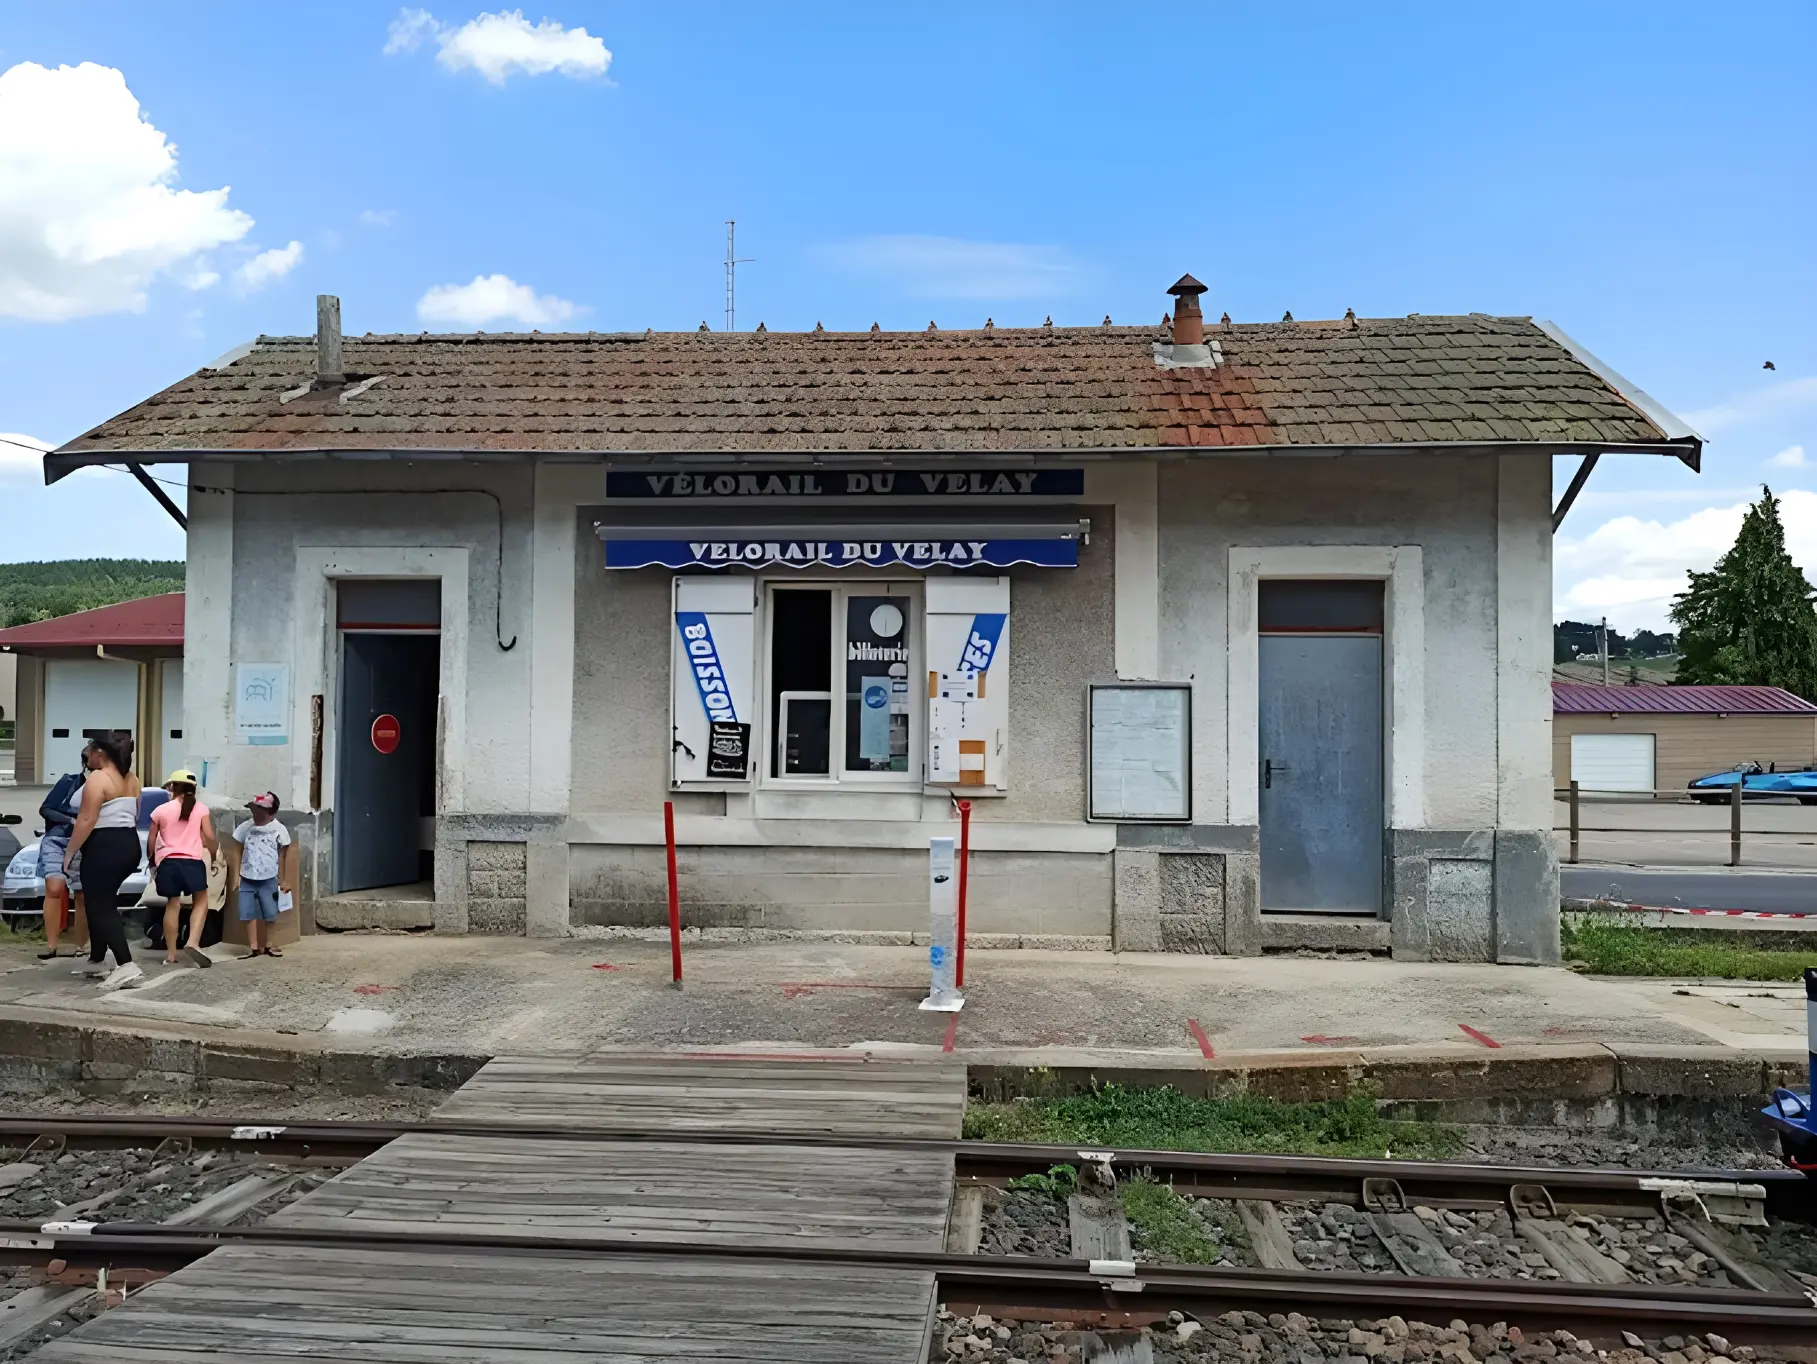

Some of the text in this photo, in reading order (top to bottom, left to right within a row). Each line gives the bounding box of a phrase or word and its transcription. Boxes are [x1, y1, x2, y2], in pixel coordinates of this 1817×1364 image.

[647, 472, 1037, 495] VÉLORAIL DU VELAY
[842, 542, 882, 559] DU
[892, 542, 988, 560] VELAY
